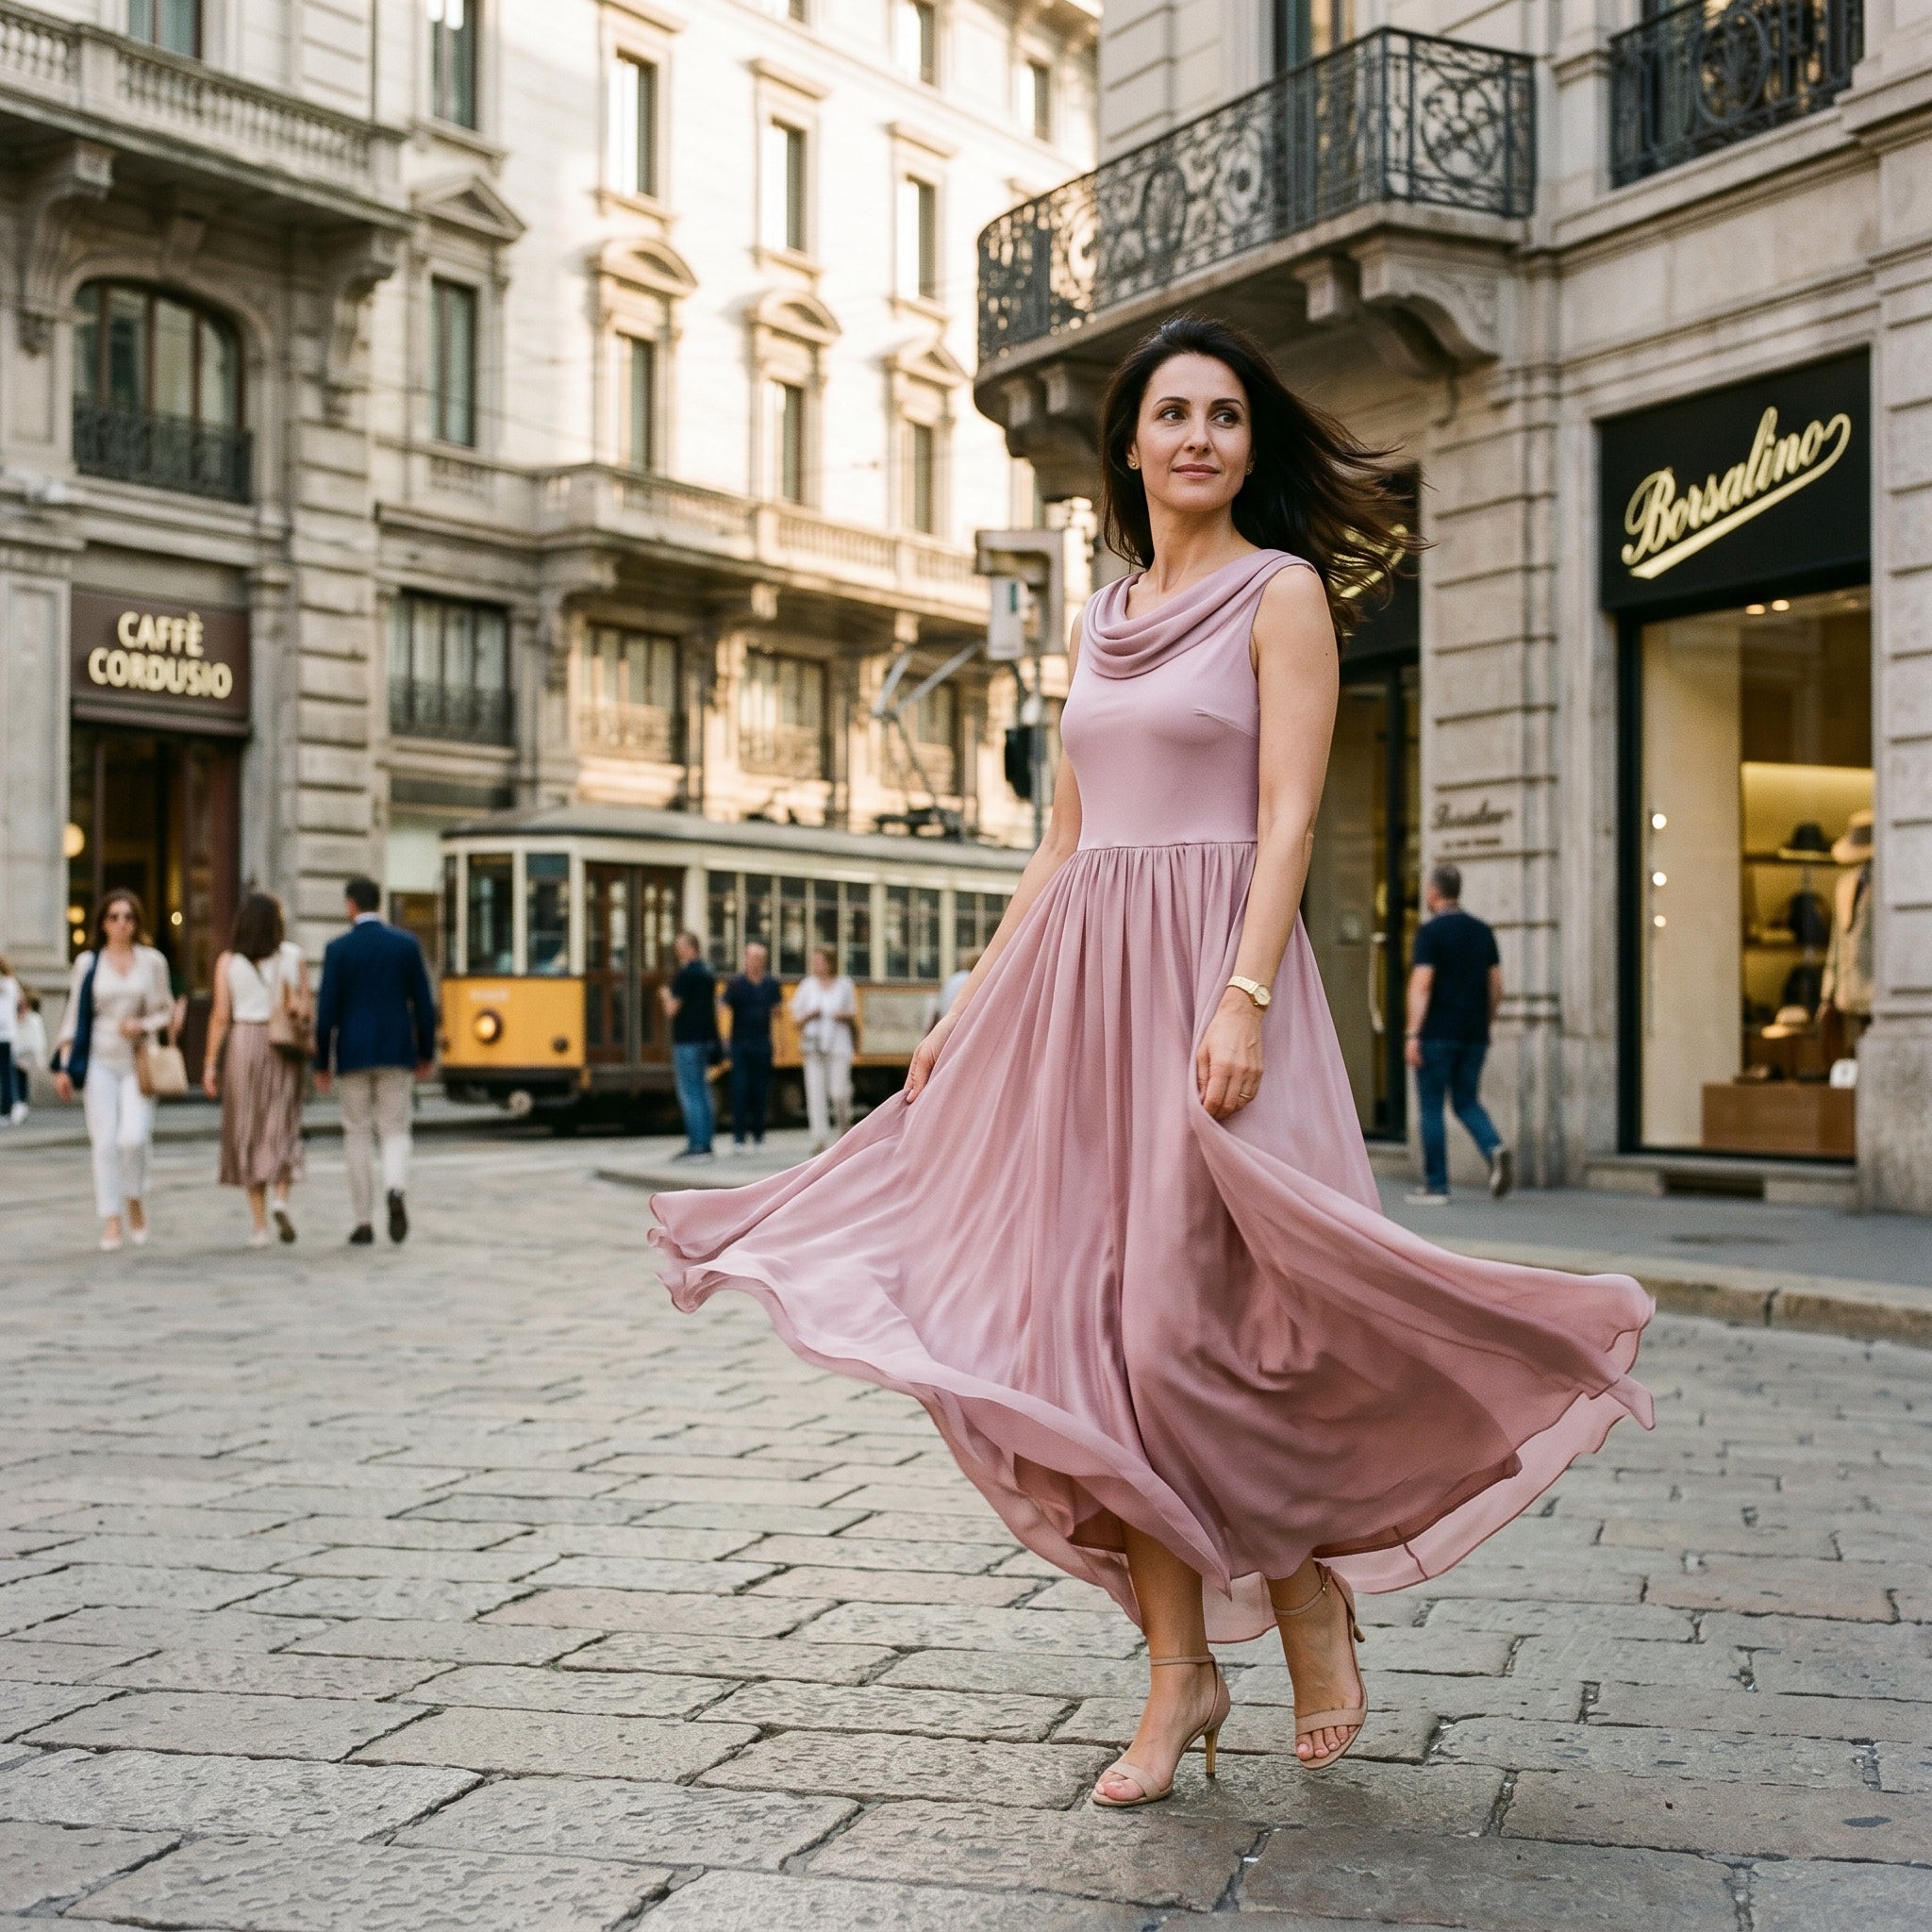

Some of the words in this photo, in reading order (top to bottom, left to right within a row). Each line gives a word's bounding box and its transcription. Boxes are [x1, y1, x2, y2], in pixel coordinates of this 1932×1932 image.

[1621, 406, 1852, 579] Borsalino
[117, 610, 205, 658] CAFFÈ
[88, 646, 233, 699] CORDUSIO
